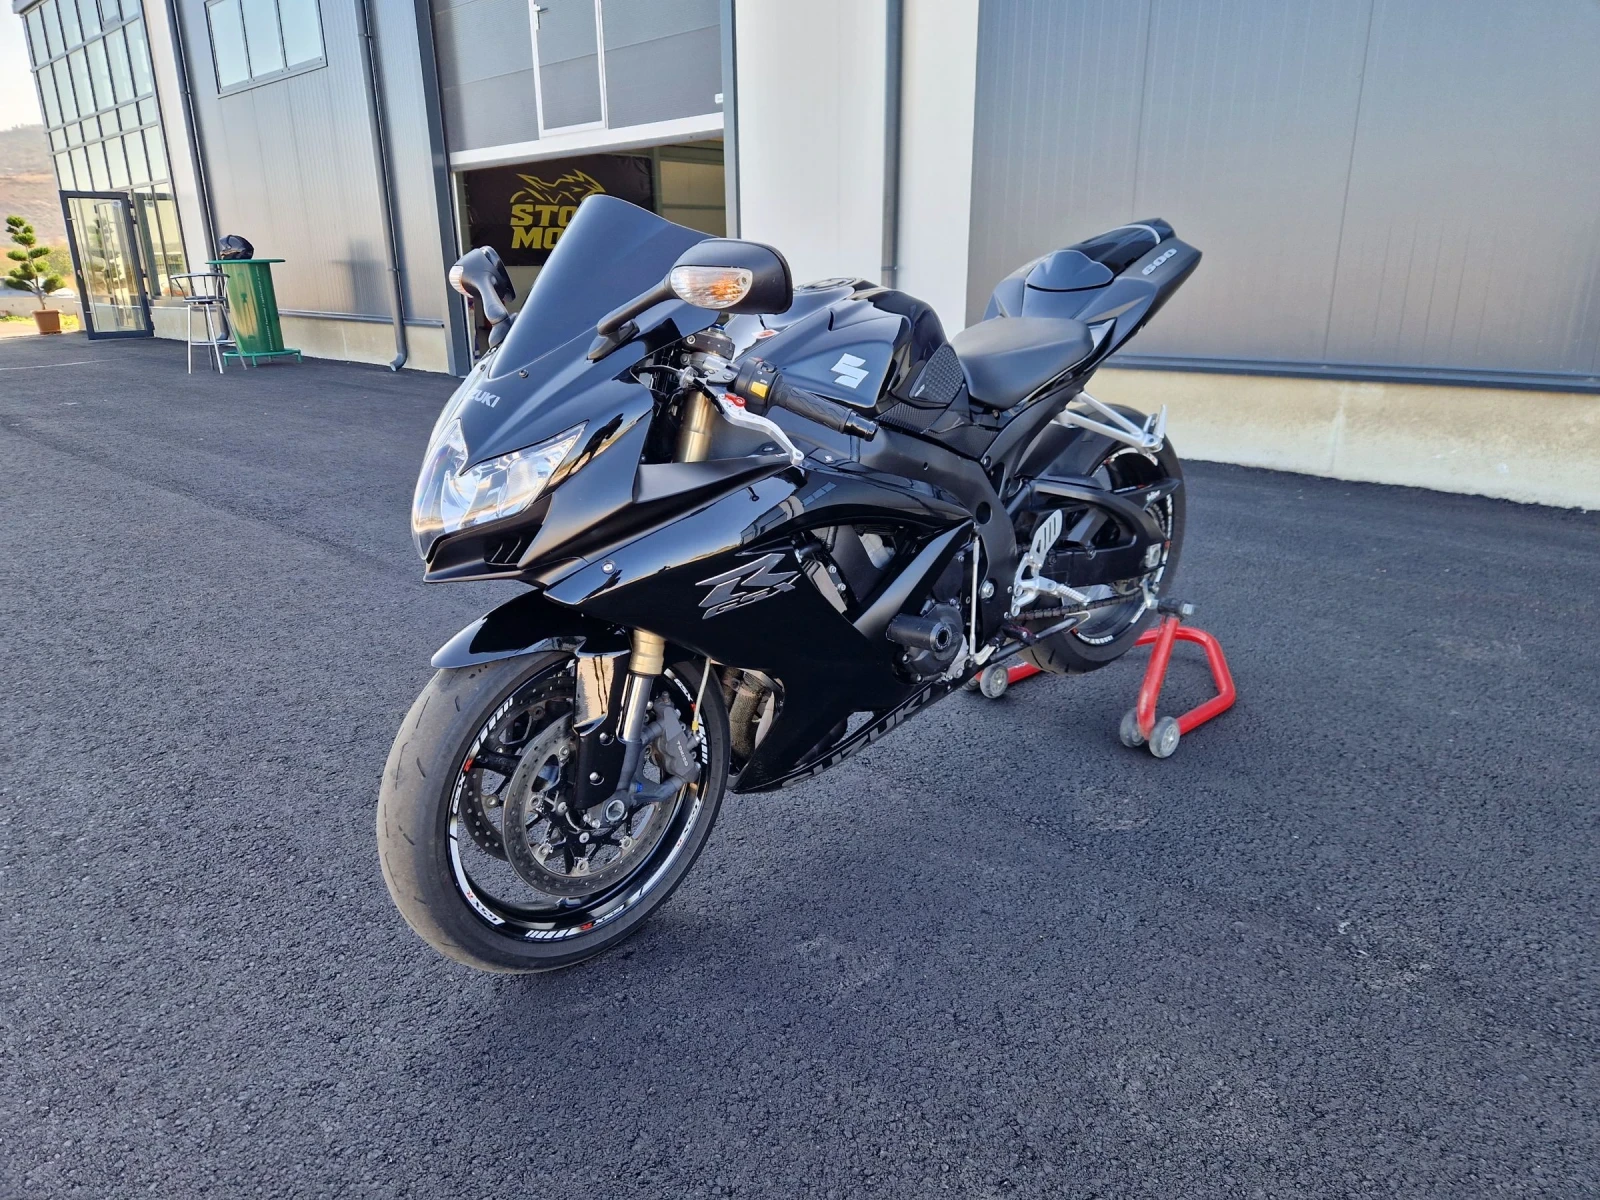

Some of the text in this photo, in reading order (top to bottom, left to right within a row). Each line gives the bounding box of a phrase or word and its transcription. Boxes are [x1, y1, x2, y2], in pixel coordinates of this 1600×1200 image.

[510, 205, 577, 226] STO
[512, 227, 564, 249] MO
[1142, 249, 1177, 275] 600
[469, 388, 501, 408] ZUKI
